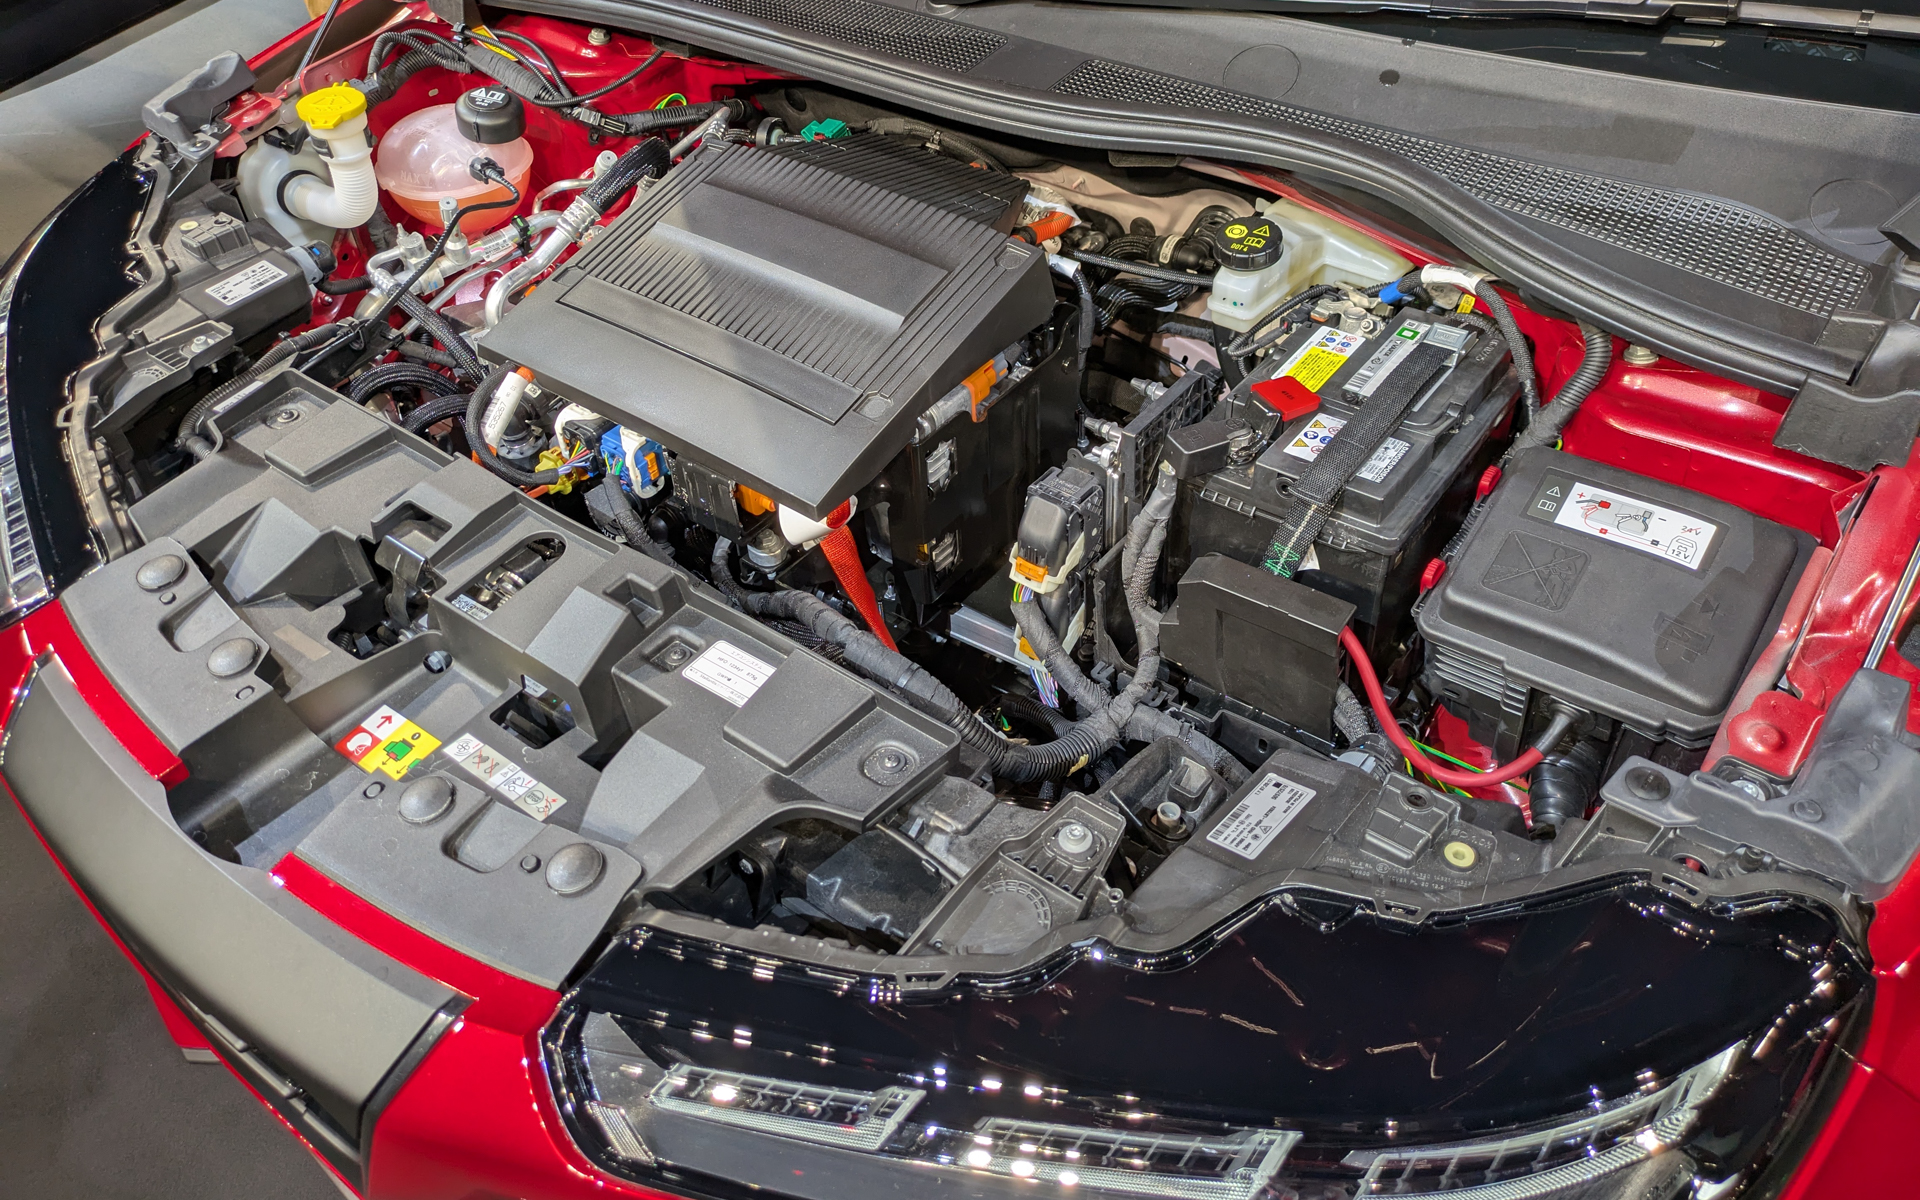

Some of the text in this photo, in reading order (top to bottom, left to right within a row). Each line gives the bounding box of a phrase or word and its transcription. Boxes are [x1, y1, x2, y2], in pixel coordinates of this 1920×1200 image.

[401, 170, 420, 184] MAX
[1383, 343, 1398, 357] VARTA
[487, 400, 507, 430] 535267
[729, 662, 744, 672] 1234yf
[1374, 889, 1385, 897] C5
